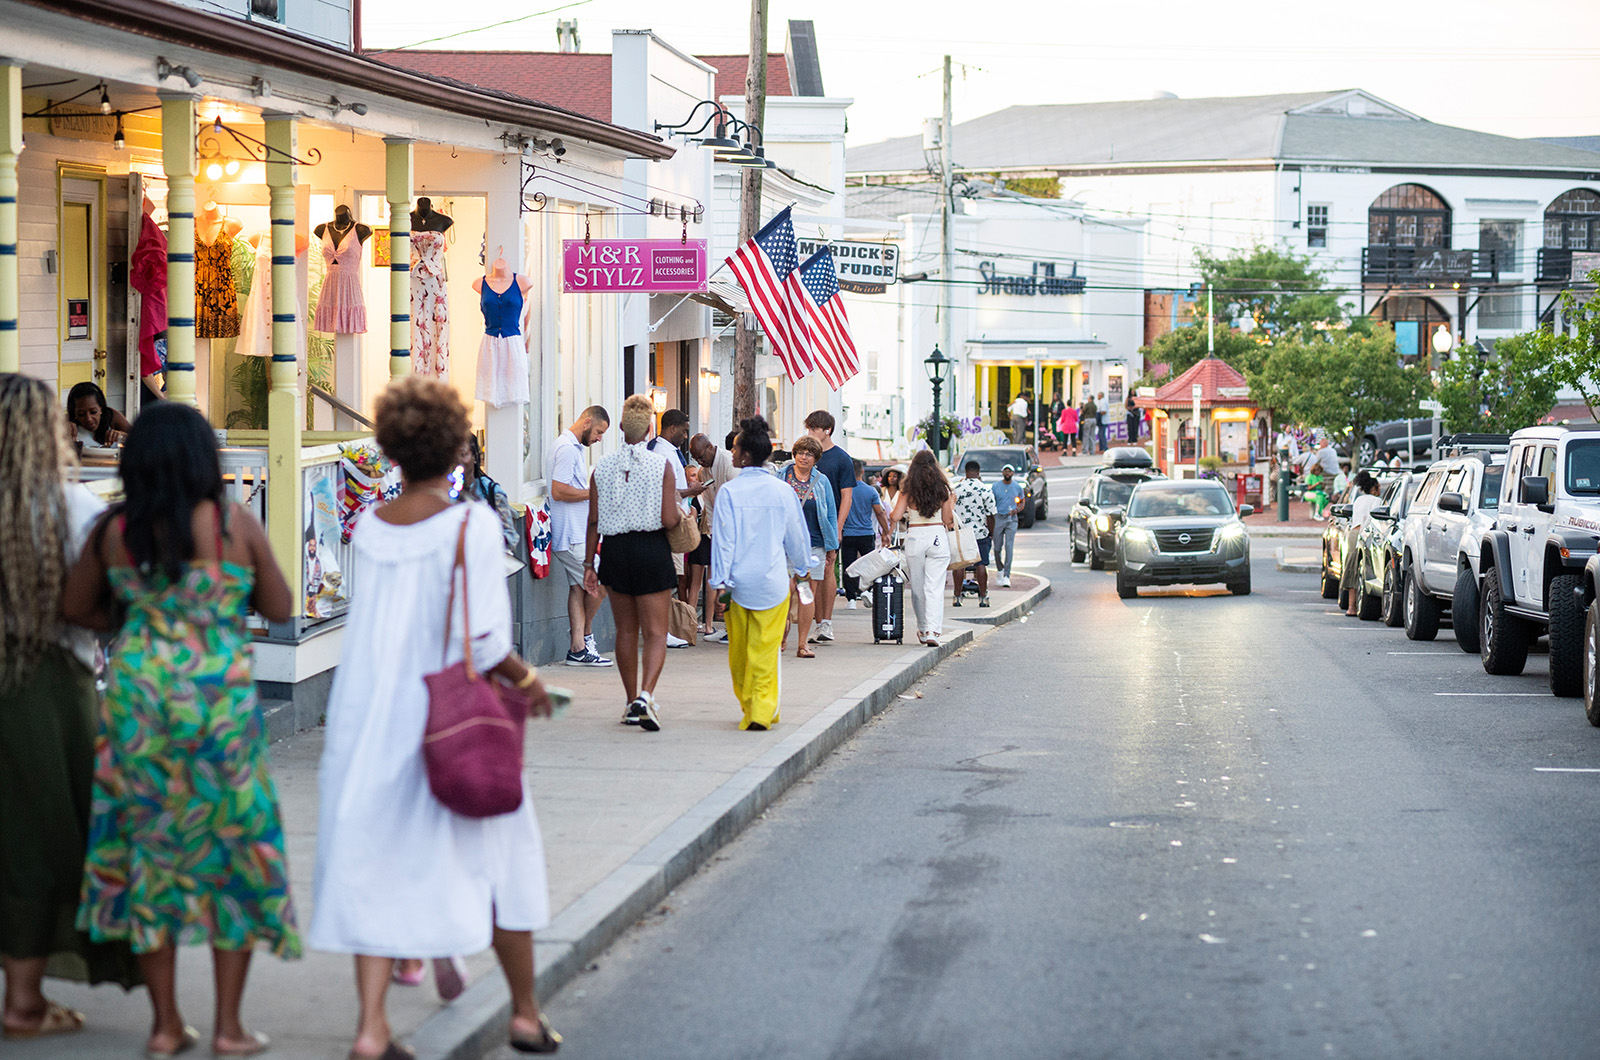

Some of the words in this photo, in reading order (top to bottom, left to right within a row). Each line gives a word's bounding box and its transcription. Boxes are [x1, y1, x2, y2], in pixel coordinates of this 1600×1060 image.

[577, 245, 642, 265] M&R
[655, 256, 684, 264] CLOTHING
[573, 267, 645, 287] STYLZ
[654, 267, 695, 276] ACCESSORIES
[840, 263, 894, 277] FUDGE
[977, 260, 1038, 296] Strand
[852, 284, 883, 293] Brittle
